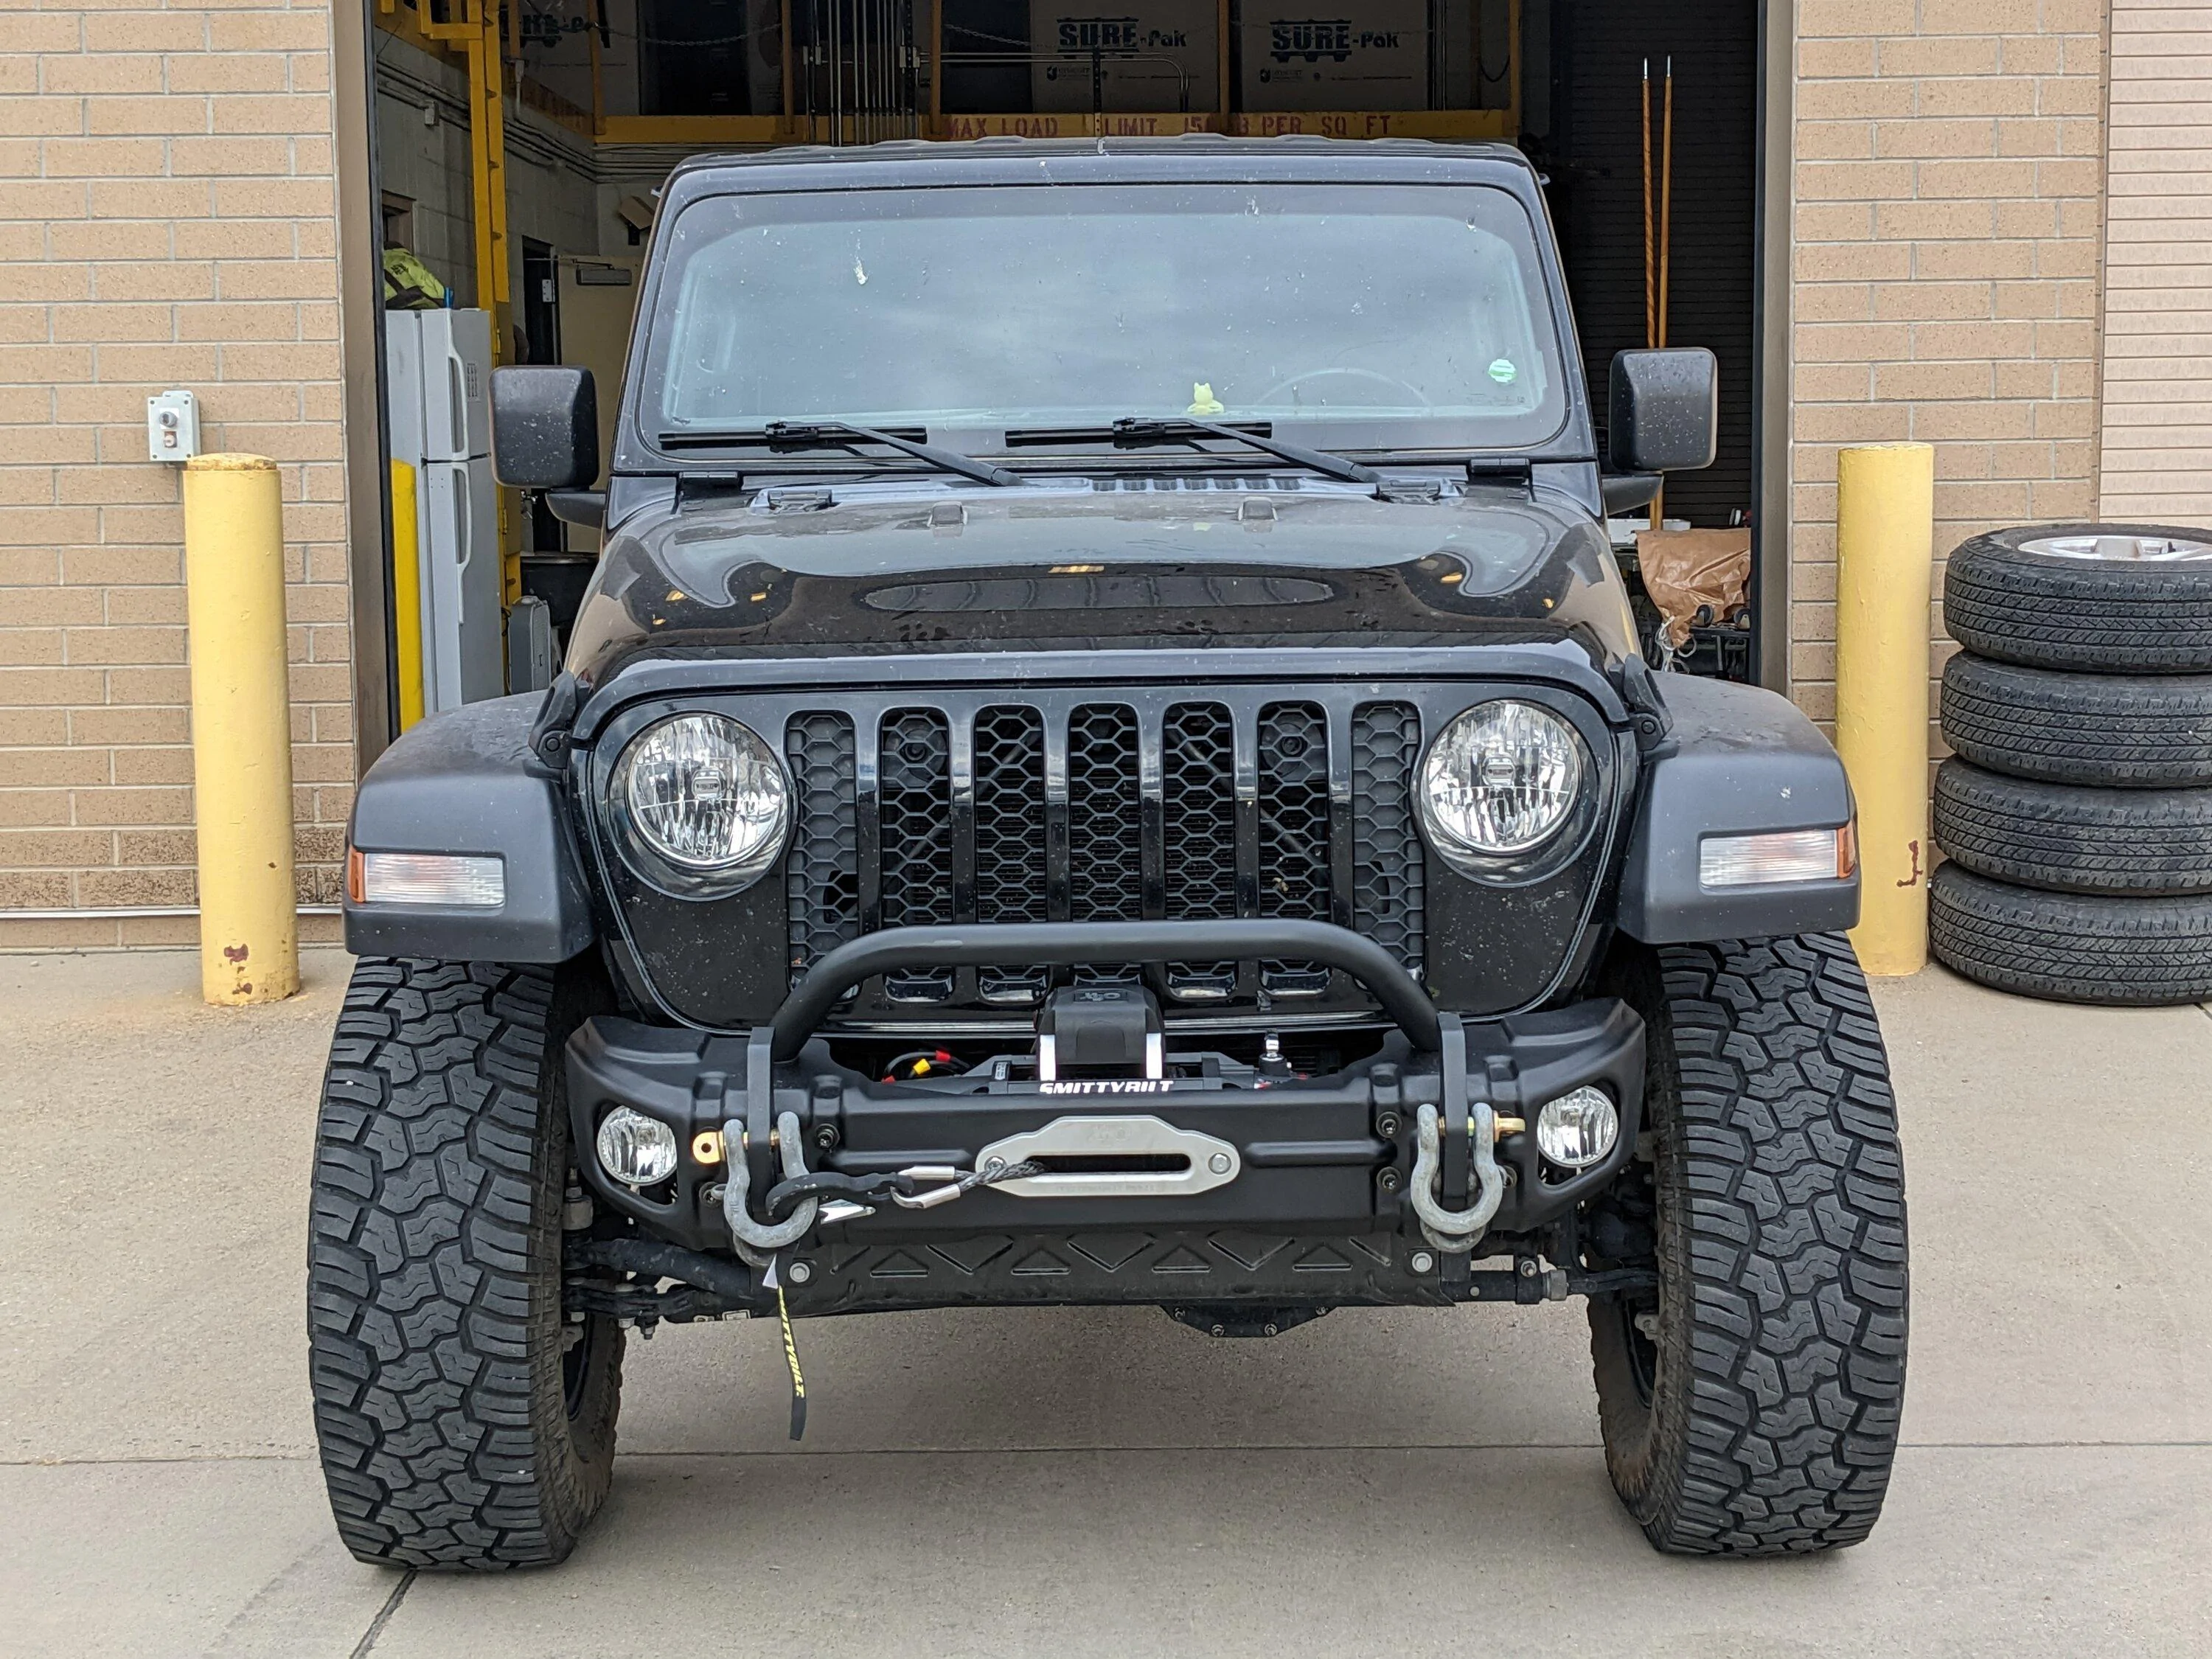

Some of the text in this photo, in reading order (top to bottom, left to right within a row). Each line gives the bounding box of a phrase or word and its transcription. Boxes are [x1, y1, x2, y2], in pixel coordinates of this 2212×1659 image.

[1272, 25, 1399, 50] SURE-Pak
[1001, 116, 1059, 136] LOAD
[1105, 116, 1158, 136] LIMIT
[1262, 115, 1302, 135] PER
[1321, 115, 1347, 136] SQ
[1365, 114, 1391, 135] FT
